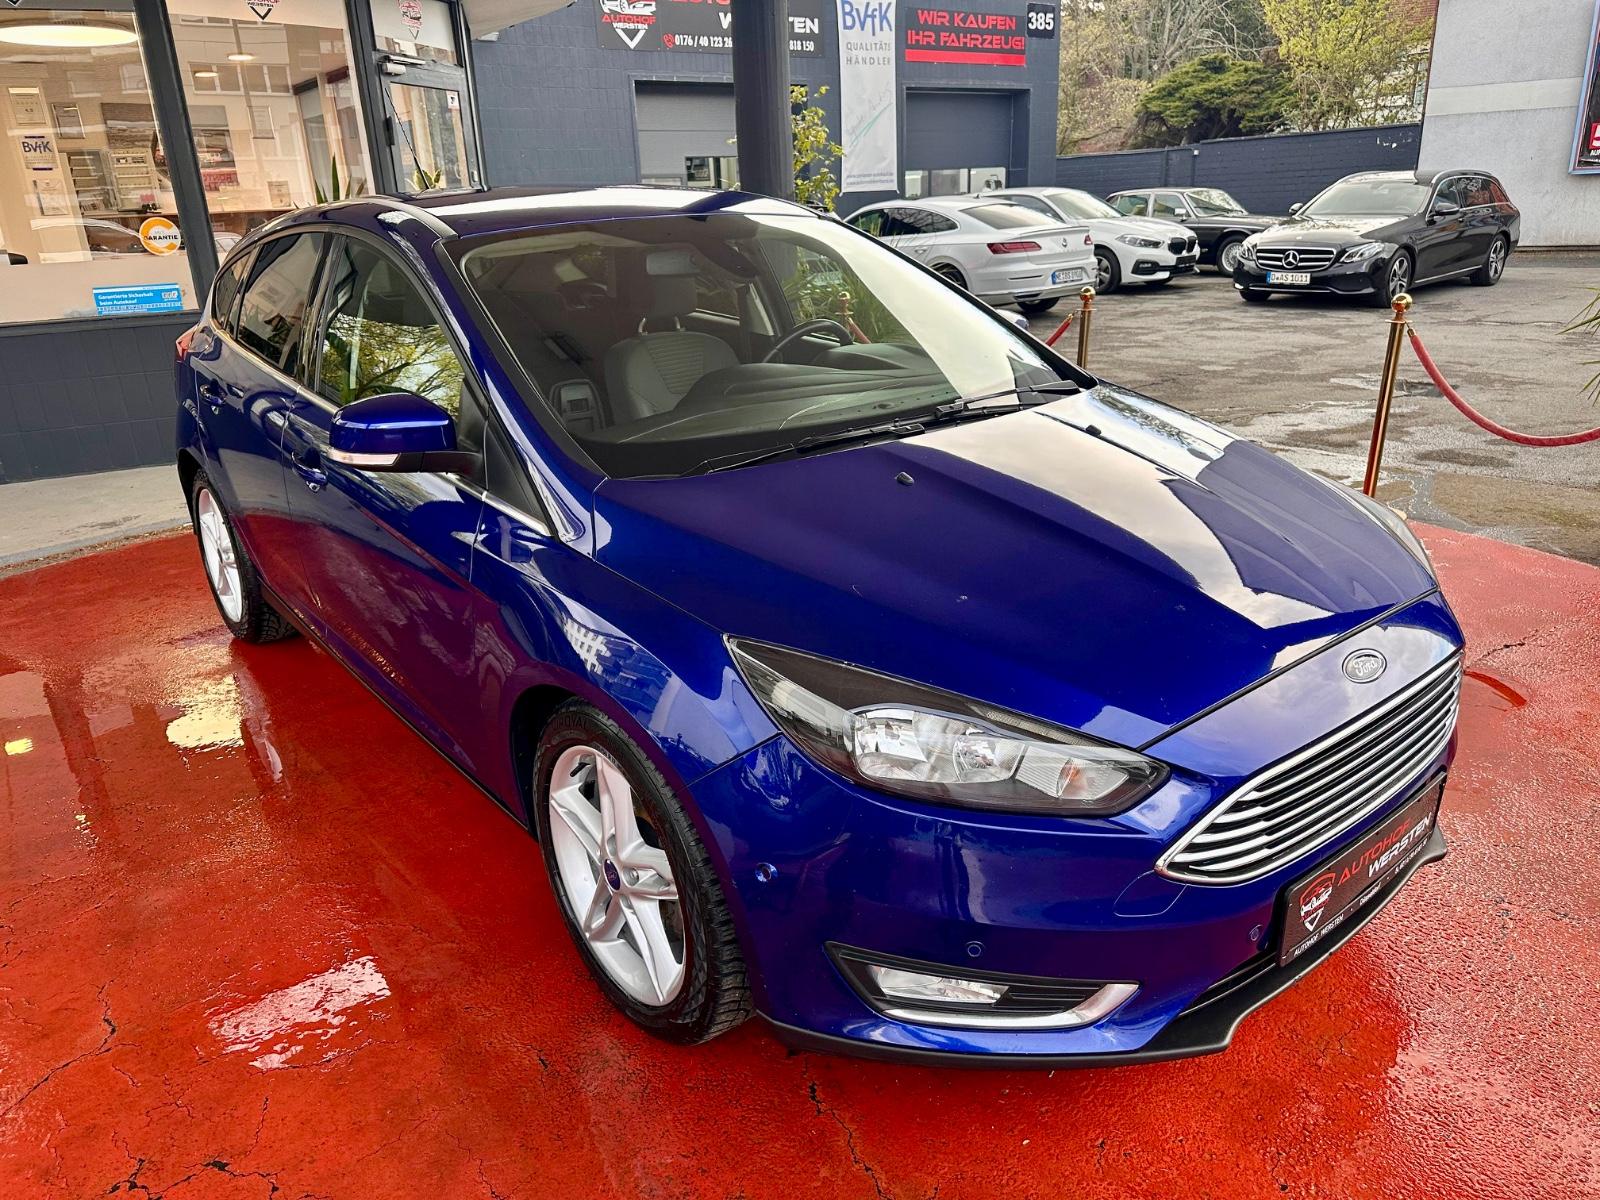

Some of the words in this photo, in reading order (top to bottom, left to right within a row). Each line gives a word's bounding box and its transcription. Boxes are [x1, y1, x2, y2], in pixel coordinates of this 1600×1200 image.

[602, 14, 656, 25] AUTOHOF
[841, 0, 893, 37] BVfK
[917, 10, 950, 26] WIR
[954, 12, 1016, 30] KAUFEN
[1028, 12, 1054, 30] 385
[674, 34, 694, 46] 0176
[710, 36, 722, 48] 123
[907, 30, 936, 46] IHR
[940, 32, 1025, 50] FAHRZEUG!
[22, 141, 53, 154] BVfK
[1353, 656, 1378, 677] Ford
[1338, 819, 1411, 887] AUTOHOF
[1368, 812, 1432, 878] WERSTEN
